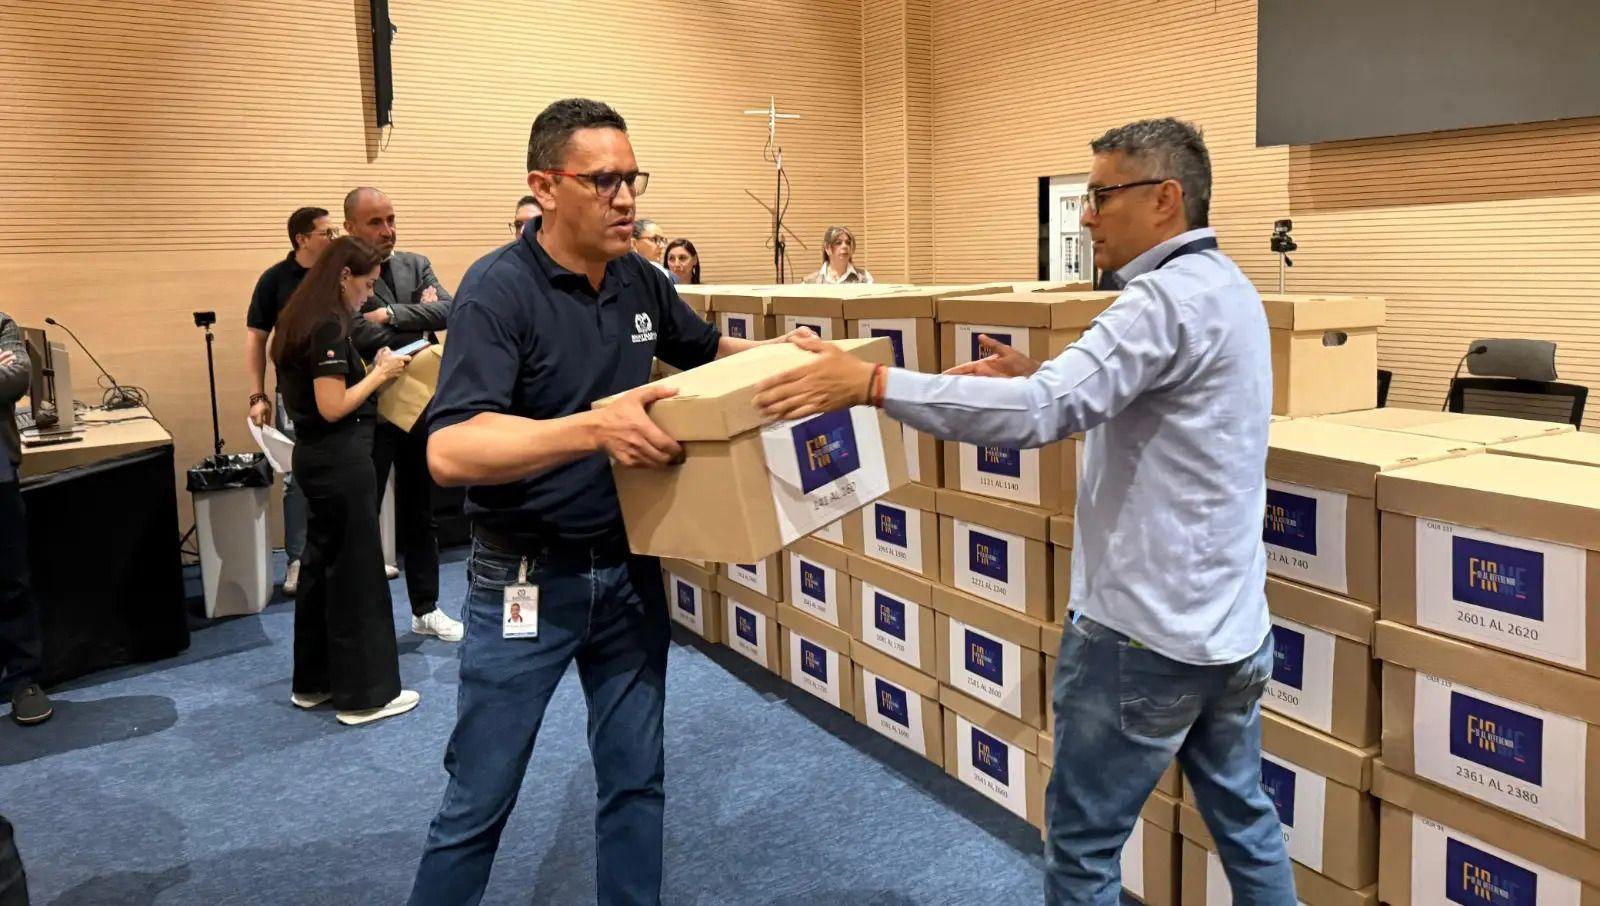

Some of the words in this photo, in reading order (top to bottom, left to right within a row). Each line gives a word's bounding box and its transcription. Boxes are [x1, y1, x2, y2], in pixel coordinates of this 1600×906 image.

[1266, 551, 1277, 561] 21
[1280, 554, 1289, 565] AL
[1293, 557, 1309, 570] 740
[1458, 611, 1486, 627] 2601
[1489, 619, 1504, 632] AL
[1508, 623, 1539, 640] 2620
[1277, 690, 1299, 706] 2500
[1456, 766, 1485, 785] 2361
[1488, 778, 1504, 792] AL
[1508, 785, 1539, 805] 2380
